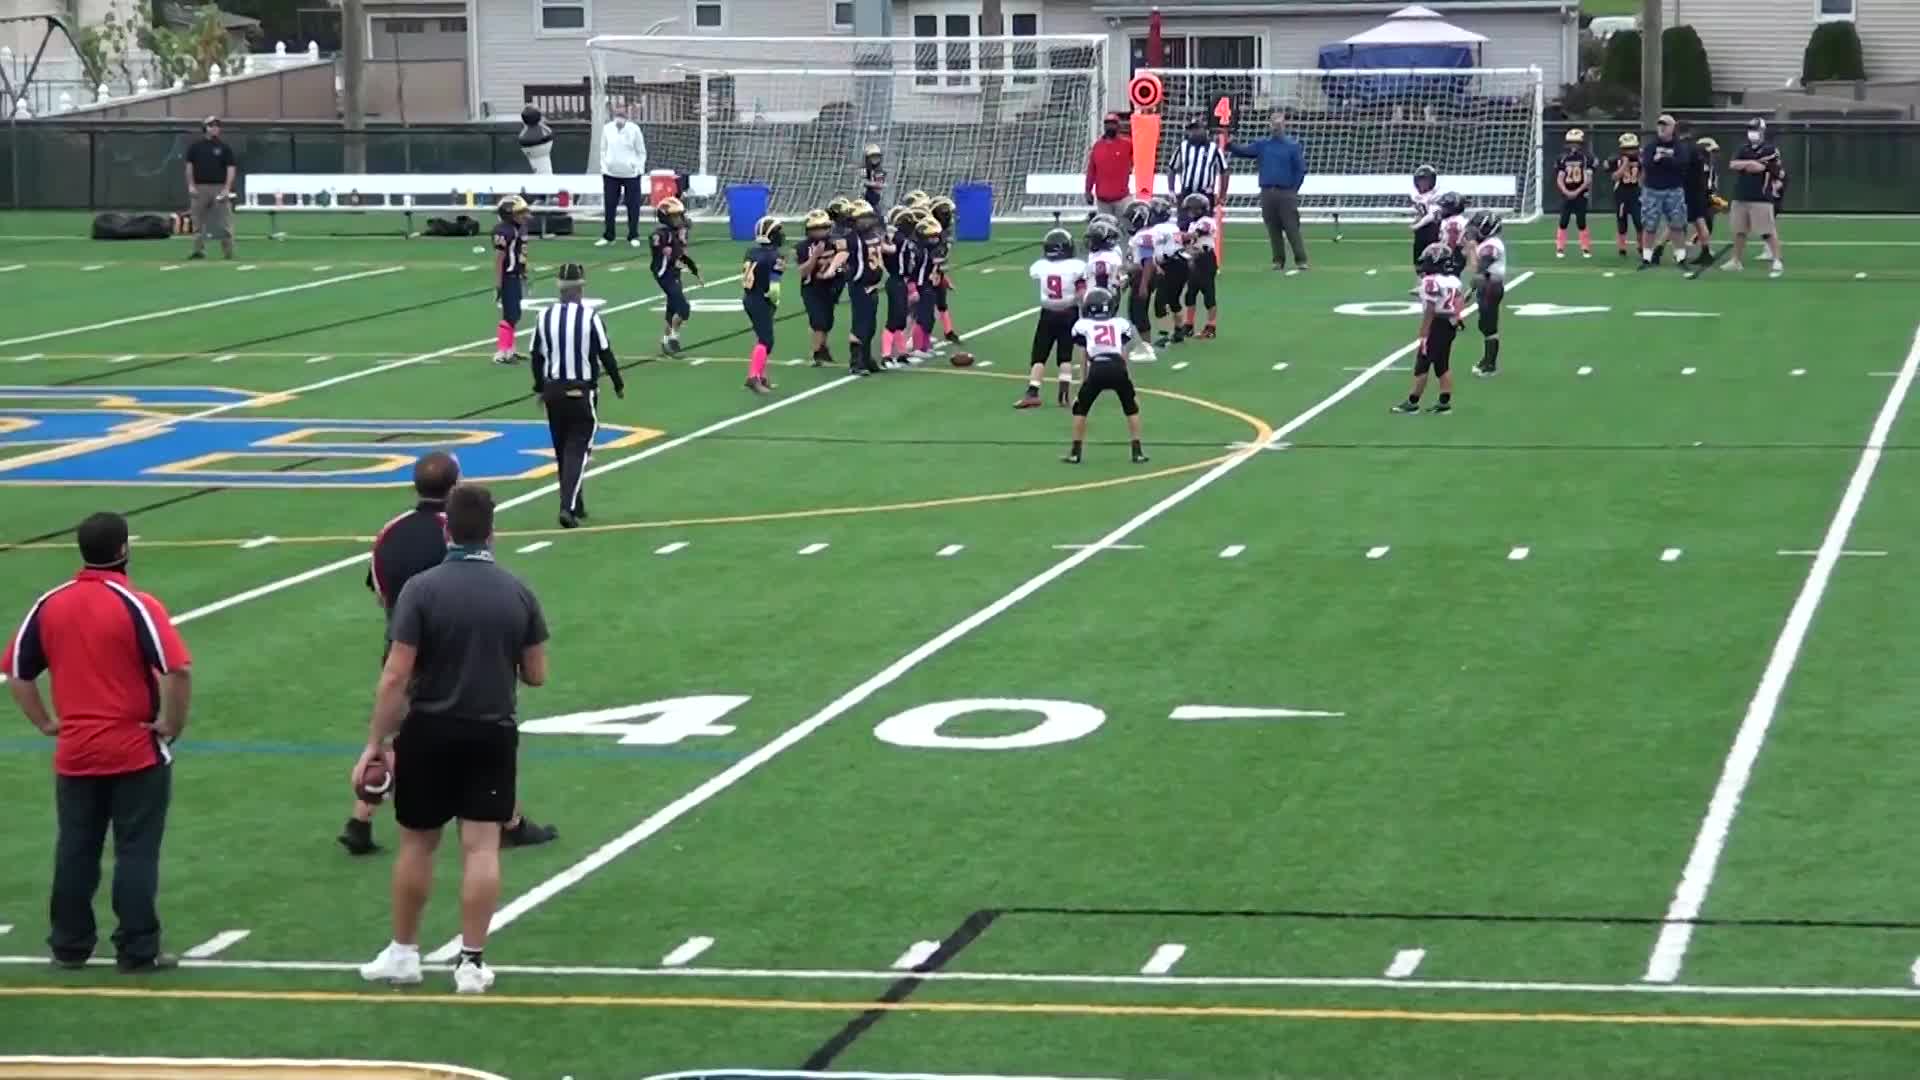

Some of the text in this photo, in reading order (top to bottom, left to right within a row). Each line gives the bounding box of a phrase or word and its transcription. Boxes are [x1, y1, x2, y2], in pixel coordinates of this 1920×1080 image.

[1214, 96, 1231, 125] 4
[1047, 275, 1063, 300] 9
[1093, 324, 1116, 348] 21
